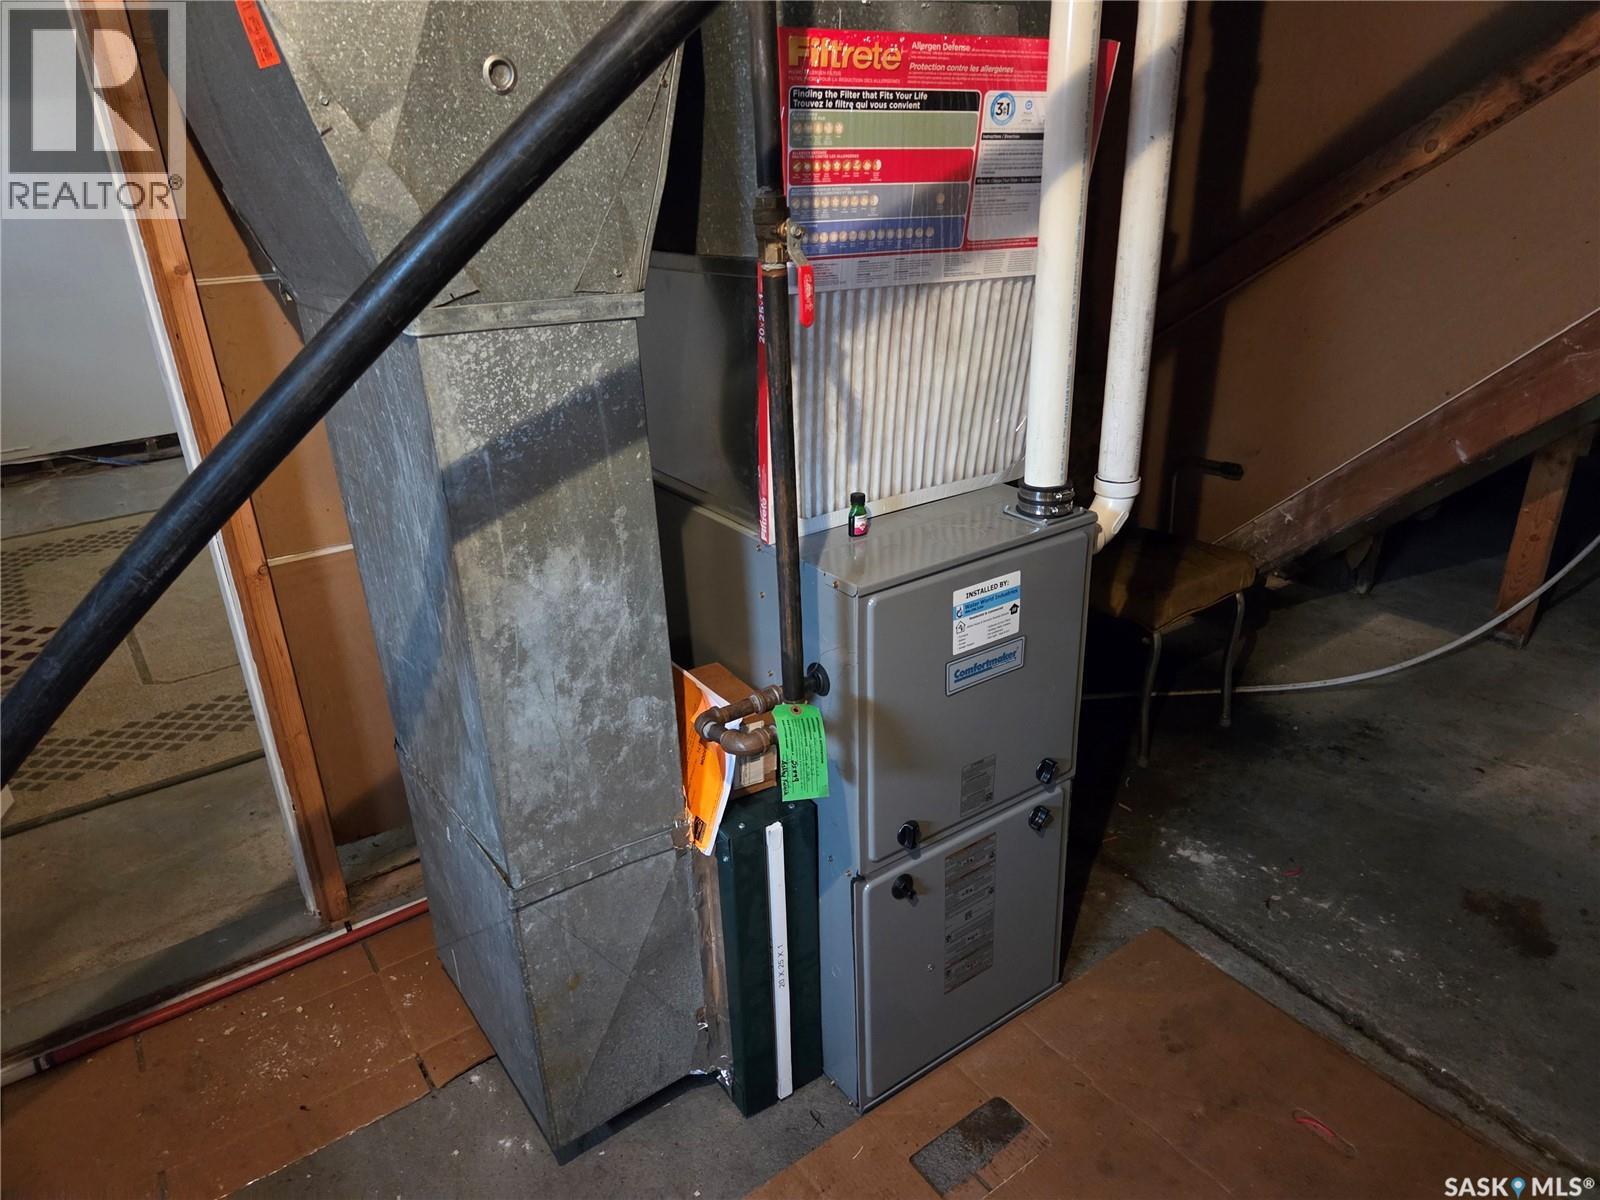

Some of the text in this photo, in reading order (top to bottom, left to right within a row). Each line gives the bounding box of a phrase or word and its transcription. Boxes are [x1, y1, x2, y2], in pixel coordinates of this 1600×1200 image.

[911, 41, 971, 52] Allergen Defense
[788, 35, 901, 70] Filtrete
[909, 62, 946, 72] Protection
[946, 64, 969, 72] contre
[970, 64, 979, 72] les
[793, 89, 928, 100] Finding the Filter that Fits Your Life
[793, 99, 920, 109] Trouvez le filtre qui vous convient
[965, 580, 1010, 599] INSTALLED BY:
[954, 650, 1017, 680] Comfortmaker
[777, 959, 785, 969] 25
